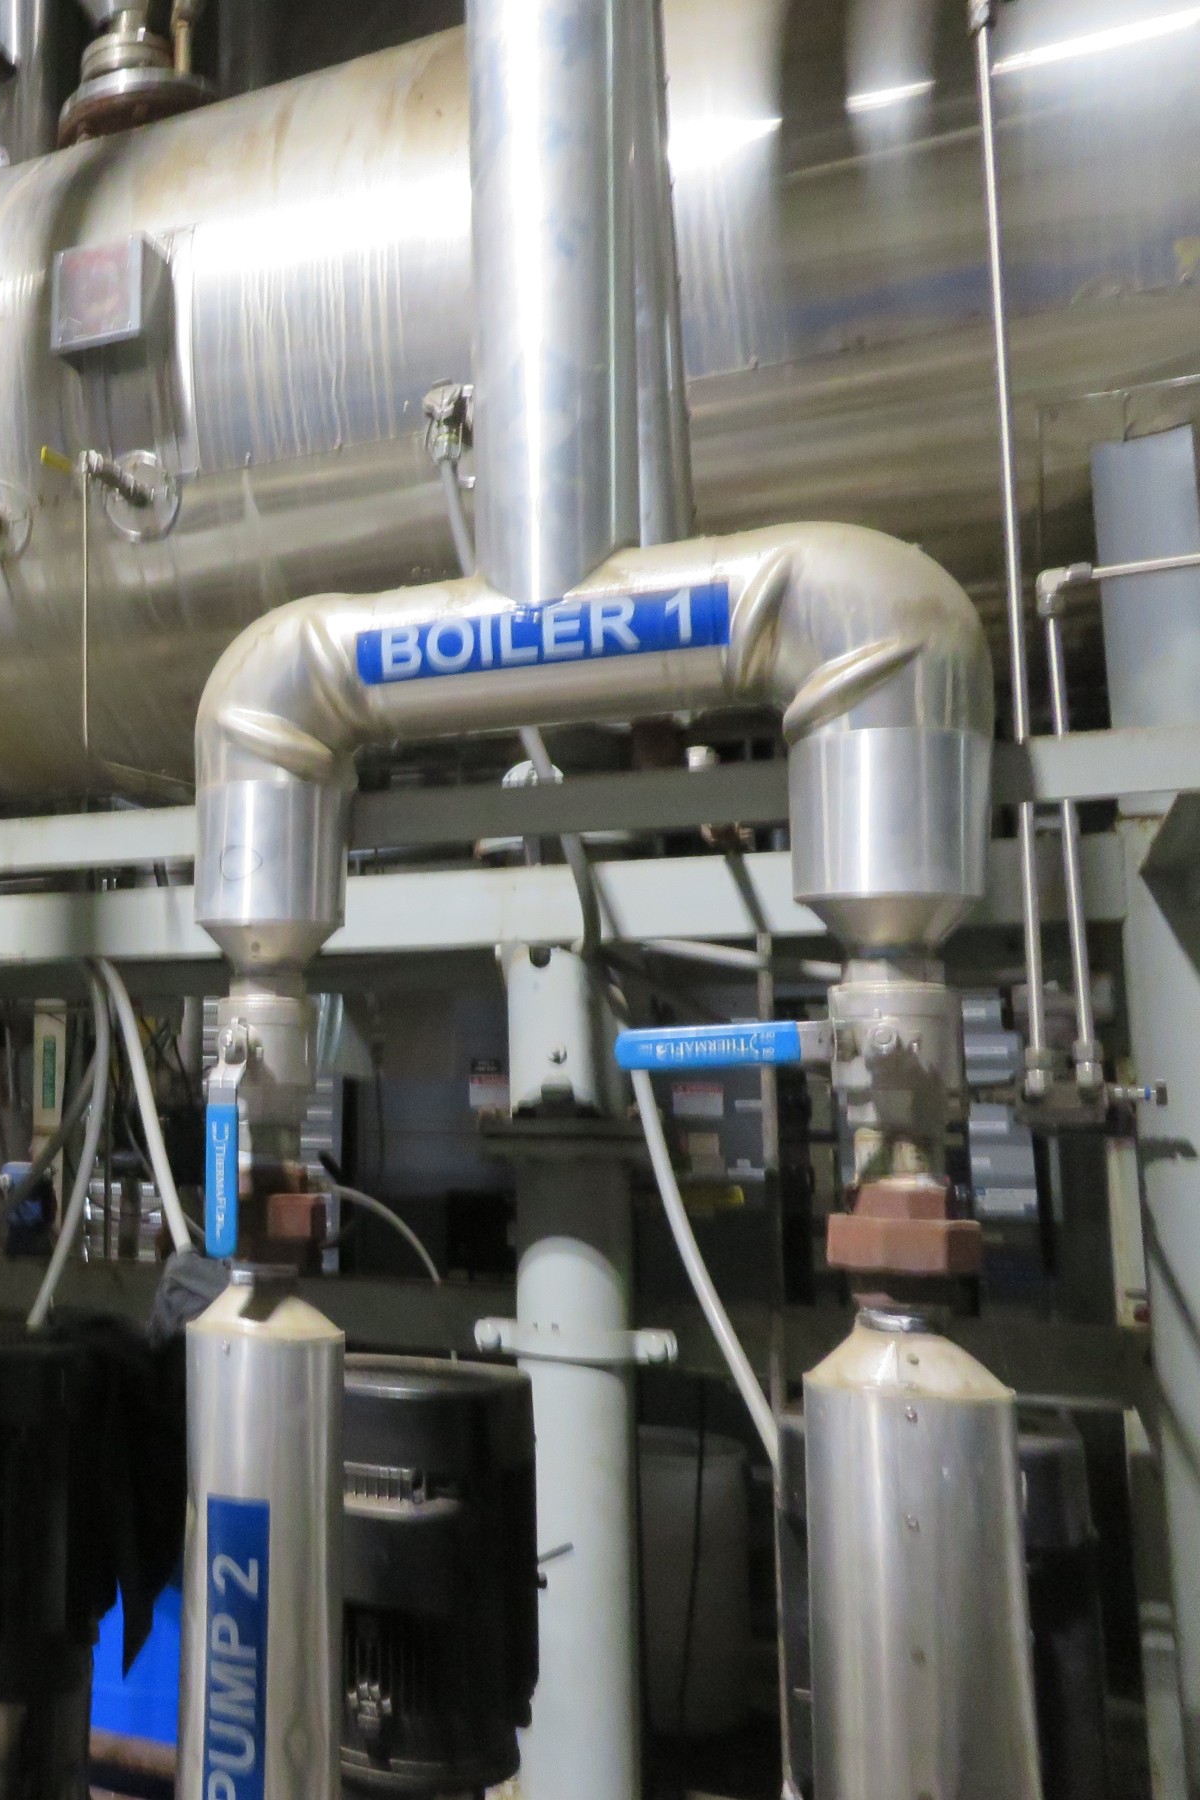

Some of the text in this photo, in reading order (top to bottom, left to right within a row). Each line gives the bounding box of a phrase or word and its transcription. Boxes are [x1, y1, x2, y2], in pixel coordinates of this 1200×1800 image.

[380, 586, 694, 680] BOILER 1
[207, 1553, 259, 1800] PUMP 2
